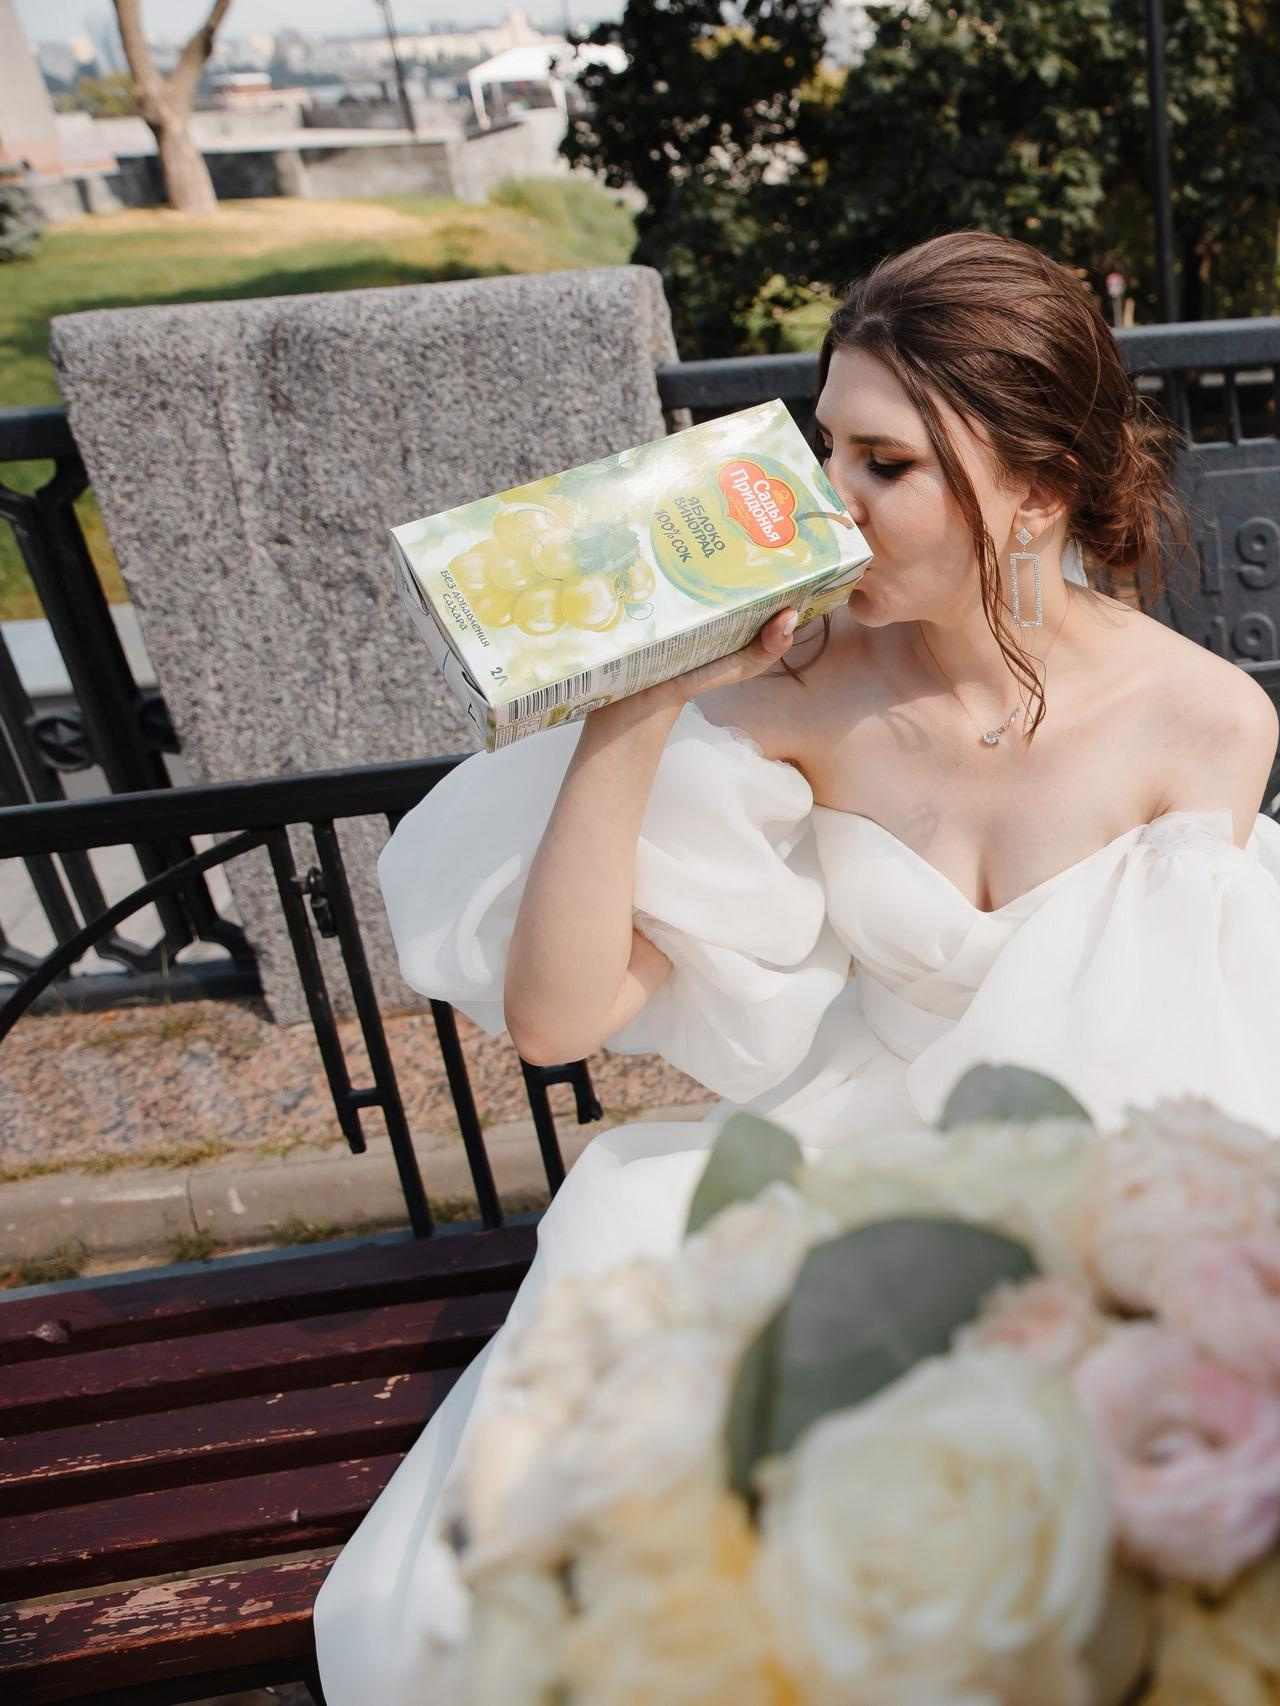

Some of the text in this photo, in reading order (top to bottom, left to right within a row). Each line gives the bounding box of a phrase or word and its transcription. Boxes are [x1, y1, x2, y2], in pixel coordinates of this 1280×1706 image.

[674, 496, 715, 558] ВИНОГРАД
[687, 496, 725, 550] ЯБЛОКО
[729, 469, 781, 542] Придонья
[754, 480, 784, 522] Сады
[654, 508, 693, 563] 100% СОК
[442, 593, 468, 631] сахара
